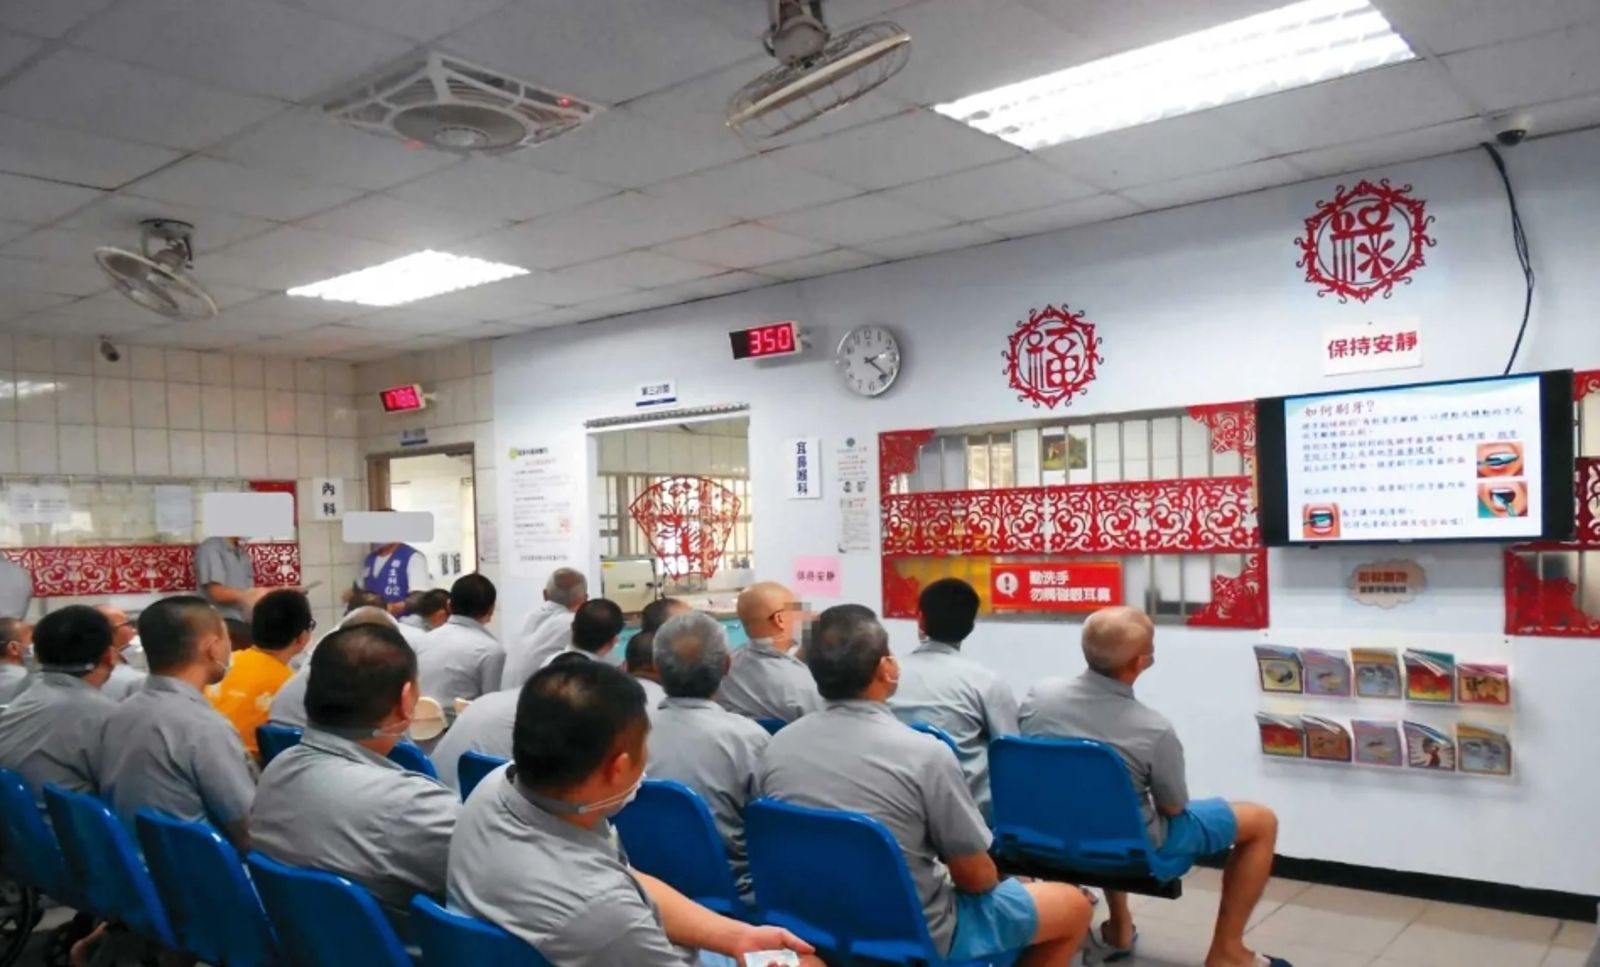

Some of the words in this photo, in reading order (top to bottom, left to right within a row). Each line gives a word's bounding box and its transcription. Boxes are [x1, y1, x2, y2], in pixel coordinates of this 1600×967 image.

[750, 326, 791, 353] 350
[1327, 331, 1418, 359] 保持安靜
[322, 482, 336, 516] 內科
